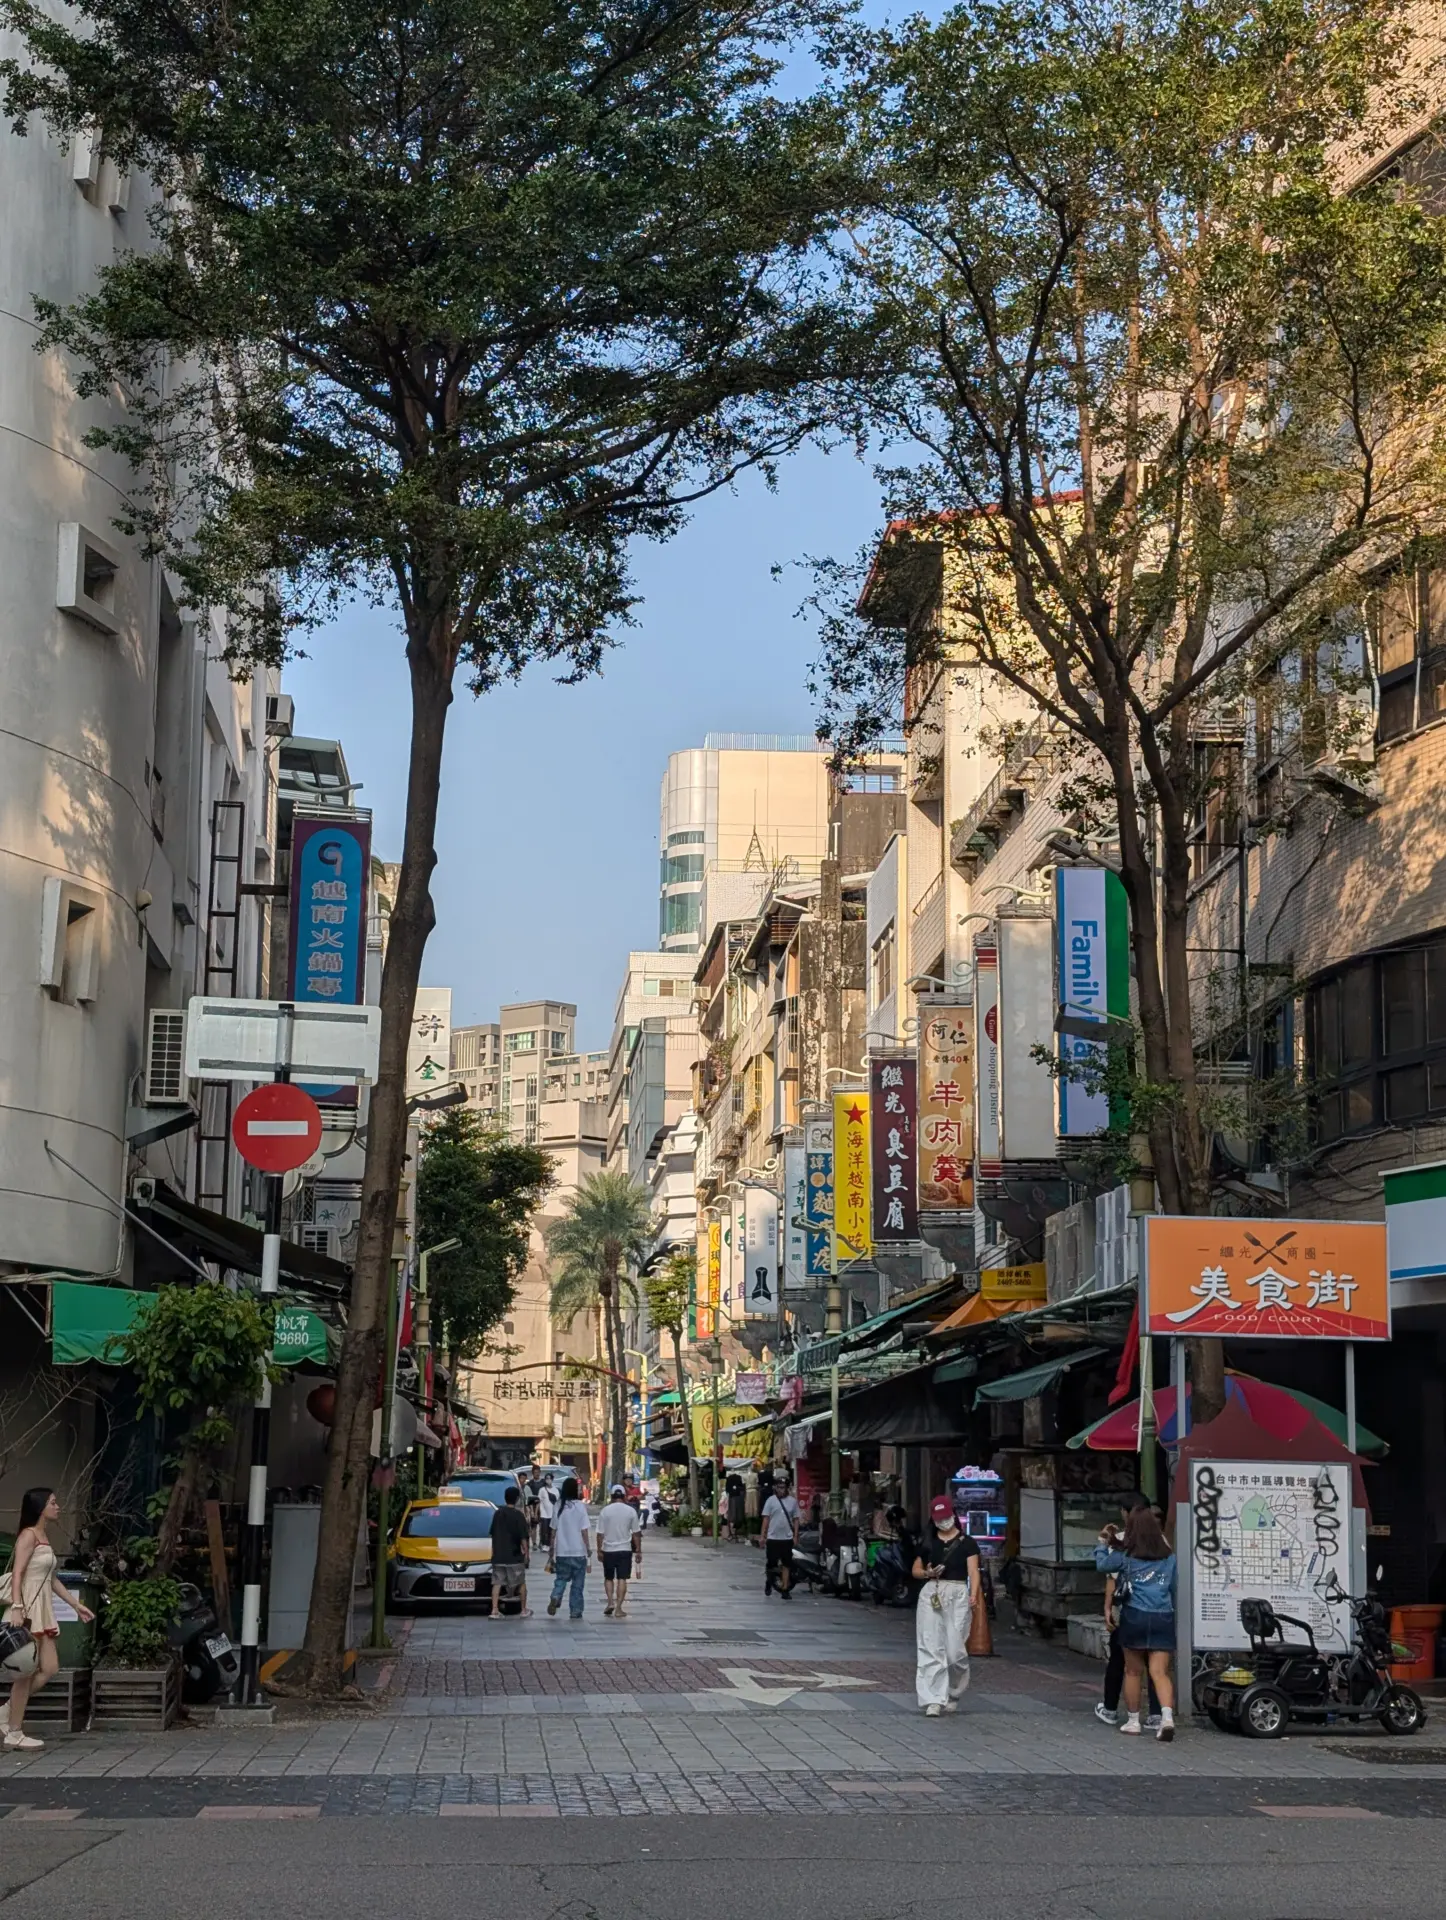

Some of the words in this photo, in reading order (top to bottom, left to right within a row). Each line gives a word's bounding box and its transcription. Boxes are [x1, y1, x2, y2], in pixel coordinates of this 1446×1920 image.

[308, 880, 347, 997] 越南火鍋專
[932, 1023, 968, 1045] 阿仁
[988, 1046, 998, 1090] Shopping
[847, 1131, 866, 1251] 海洋越南小吃
[1165, 1265, 1359, 1324] 美食街
[1268, 1315, 1323, 1323] COURT
